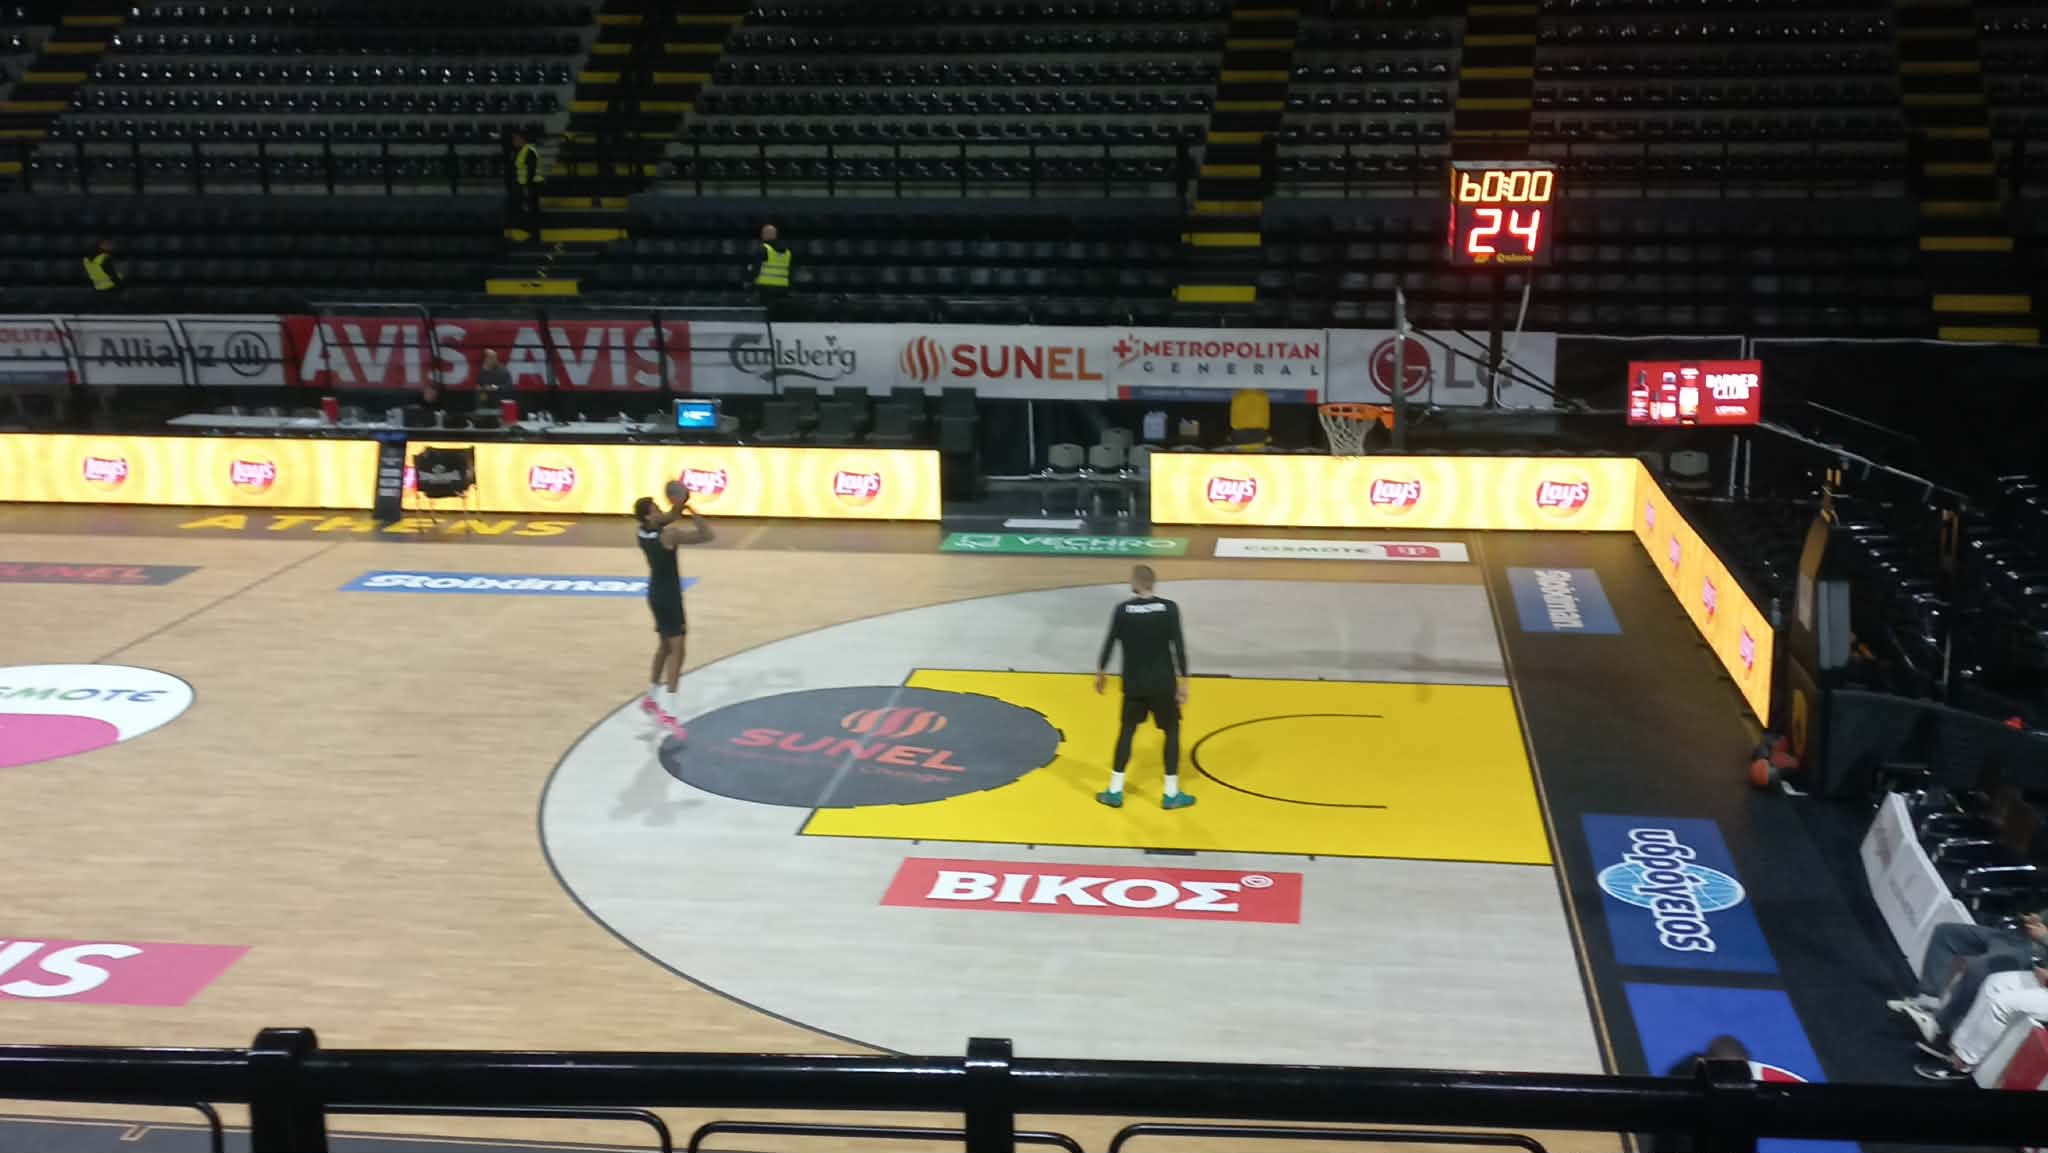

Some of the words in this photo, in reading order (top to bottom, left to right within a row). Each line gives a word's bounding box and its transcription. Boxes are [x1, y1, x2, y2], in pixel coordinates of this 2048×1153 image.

[1459, 171, 1554, 202] 60:00
[1468, 208, 1540, 253] 24
[301, 324, 470, 385] AVIS
[506, 327, 678, 387] AVIS
[730, 333, 857, 381] Carlsberg
[951, 344, 1104, 381] SUNEL
[1143, 341, 1320, 359] METROPOLITAN
[1143, 361, 1320, 376] GENERAL
[1210, 478, 1256, 504] Lay's
[1372, 480, 1420, 507] Lay's
[1540, 482, 1588, 507] Lay's
[176, 514, 576, 536] ATHENS
[729, 728, 967, 772] SUNEL
